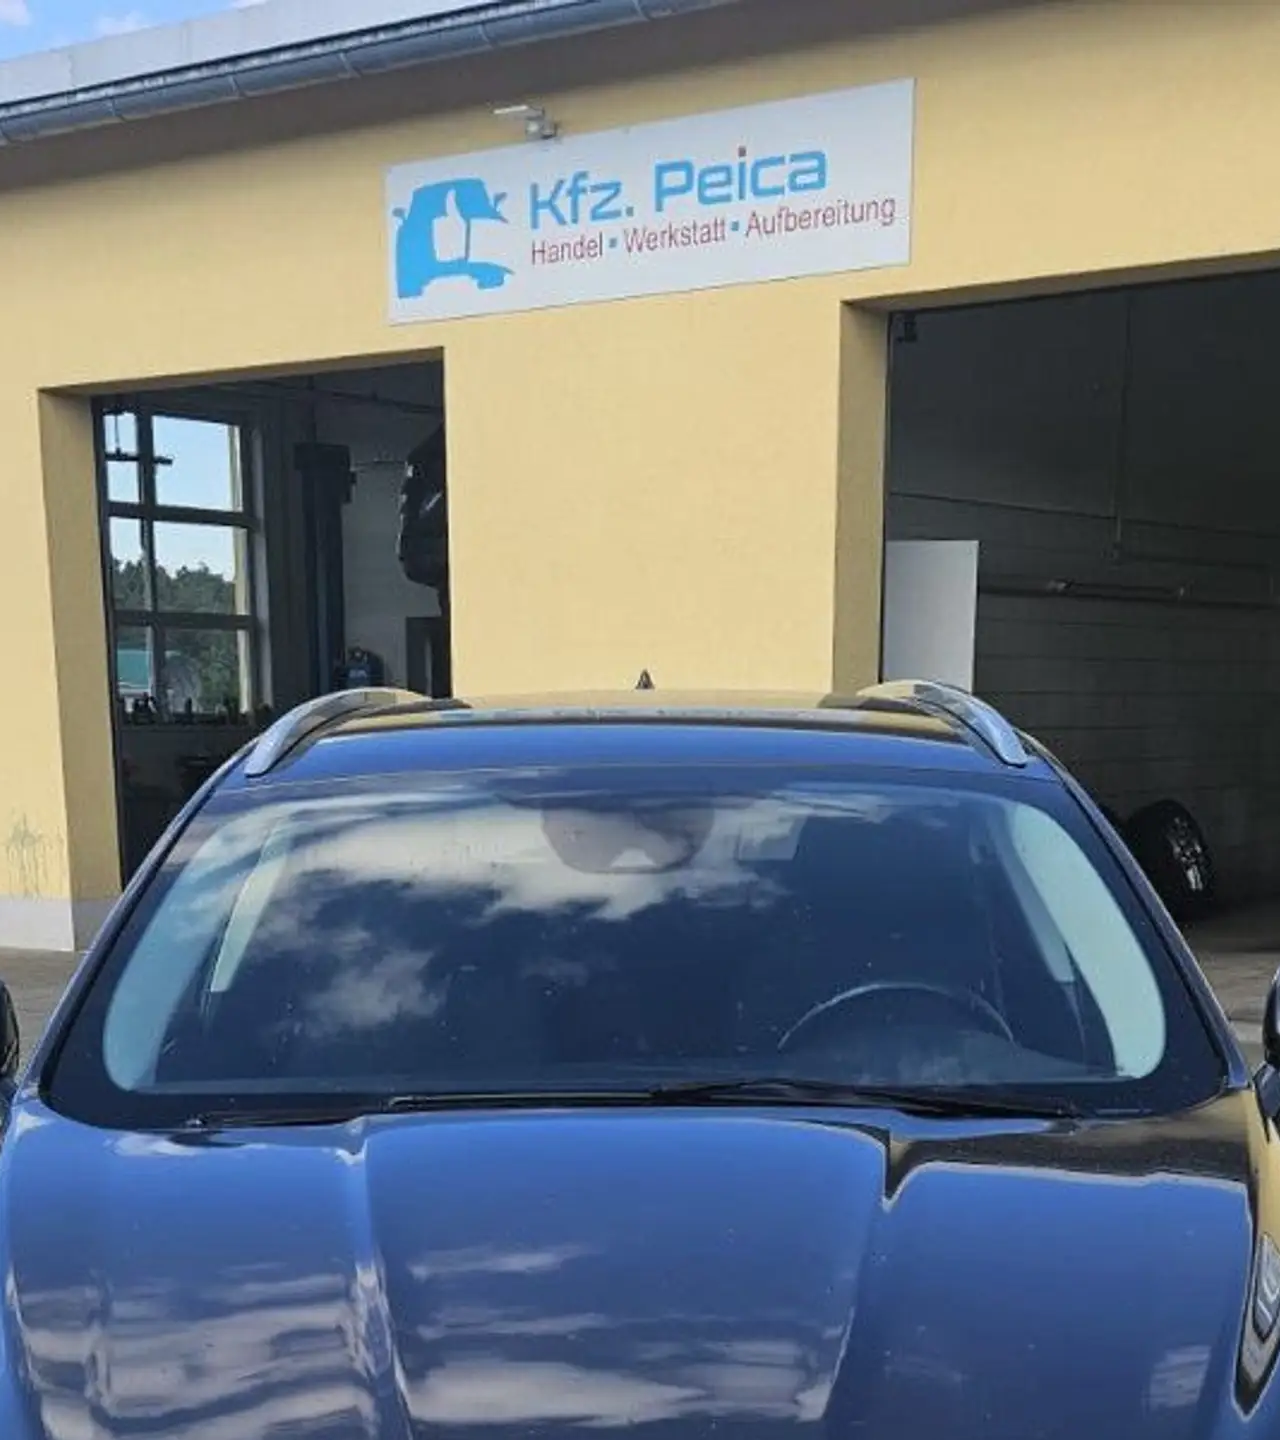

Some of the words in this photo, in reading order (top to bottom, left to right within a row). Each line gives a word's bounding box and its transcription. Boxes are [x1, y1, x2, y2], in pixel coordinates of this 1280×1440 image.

[530, 170, 635, 229] Kfz.
[655, 145, 827, 212] Peica
[530, 232, 605, 265] Handel
[623, 216, 726, 254] Werkstatt
[744, 196, 897, 239] Aufbereitung
